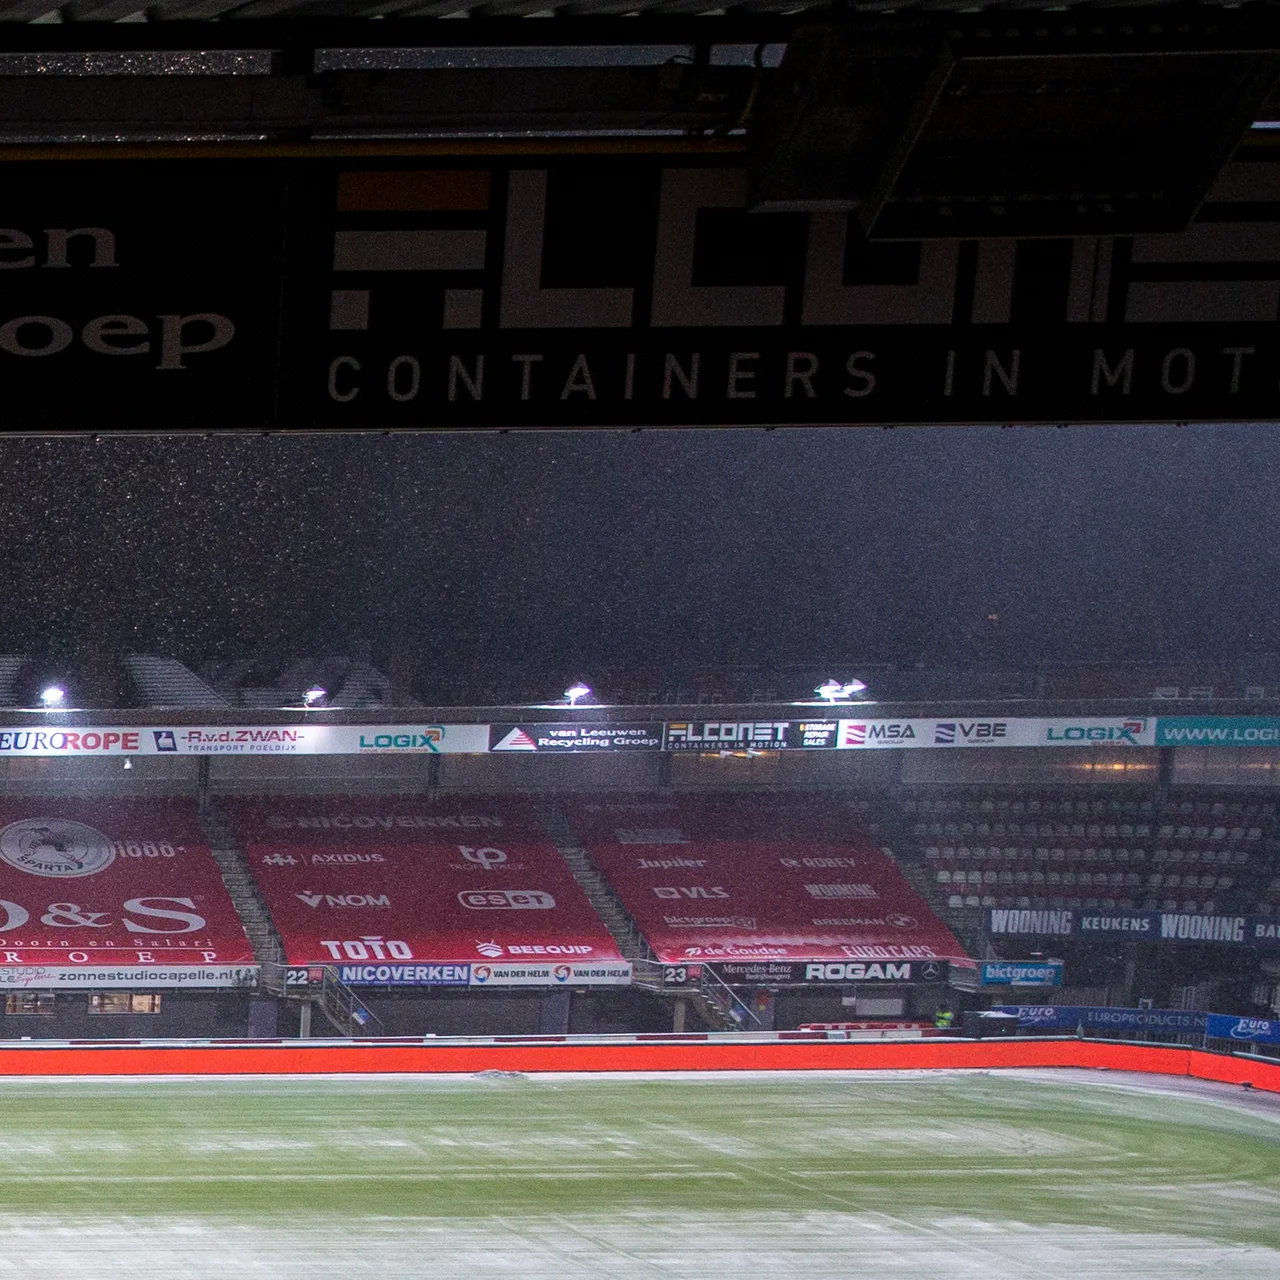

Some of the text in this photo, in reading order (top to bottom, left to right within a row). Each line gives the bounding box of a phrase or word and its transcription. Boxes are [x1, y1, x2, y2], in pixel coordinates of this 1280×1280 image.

[326, 346, 1280, 403] CONTAINERS IN MOT
[549, 728, 646, 737] van Leeuwen
[804, 723, 836, 731] STORAGE
[869, 724, 916, 739] MSA
[959, 723, 1007, 738] VBE
[1046, 726, 1134, 744] LOGIX
[187, 744, 297, 752] TRANSPORT POELDIJK
[359, 735, 436, 751] LOGIX
[538, 737, 659, 747] Recycling Groep
[750, 741, 787, 749] MOTION
[803, 738, 826, 746] SALES
[297, 815, 504, 829] NICOVERKEN
[117, 840, 177, 858] 1888
[16, 855, 74, 873] SPARTA
[310, 853, 384, 863] AXIDUS
[637, 858, 707, 869] Jupiler
[680, 886, 730, 899] VLS
[327, 894, 391, 908] NOM
[812, 918, 885, 927] BREEMAN
[991, 909, 1245, 941] WOONING KEUKENS WOONING
[88, 939, 115, 947] en
[133, 938, 214, 947] Salari
[507, 945, 593, 955] BEEQUIP
[704, 946, 788, 956] de Goudse
[841, 945, 937, 958] EURO CAPS
[342, 965, 469, 980] NICOVERKEN
[493, 970, 550, 978] VAN DER HELM
[573, 969, 630, 978] VAN DER HELM
[665, 968, 686, 982] 23
[722, 963, 792, 974] Mercedes-Benz
[805, 963, 911, 979] ROGAM
[986, 964, 1056, 981] bictgroep
[58, 968, 233, 983] zonnestudiocapelle.nl
[286, 970, 309, 985] 22
